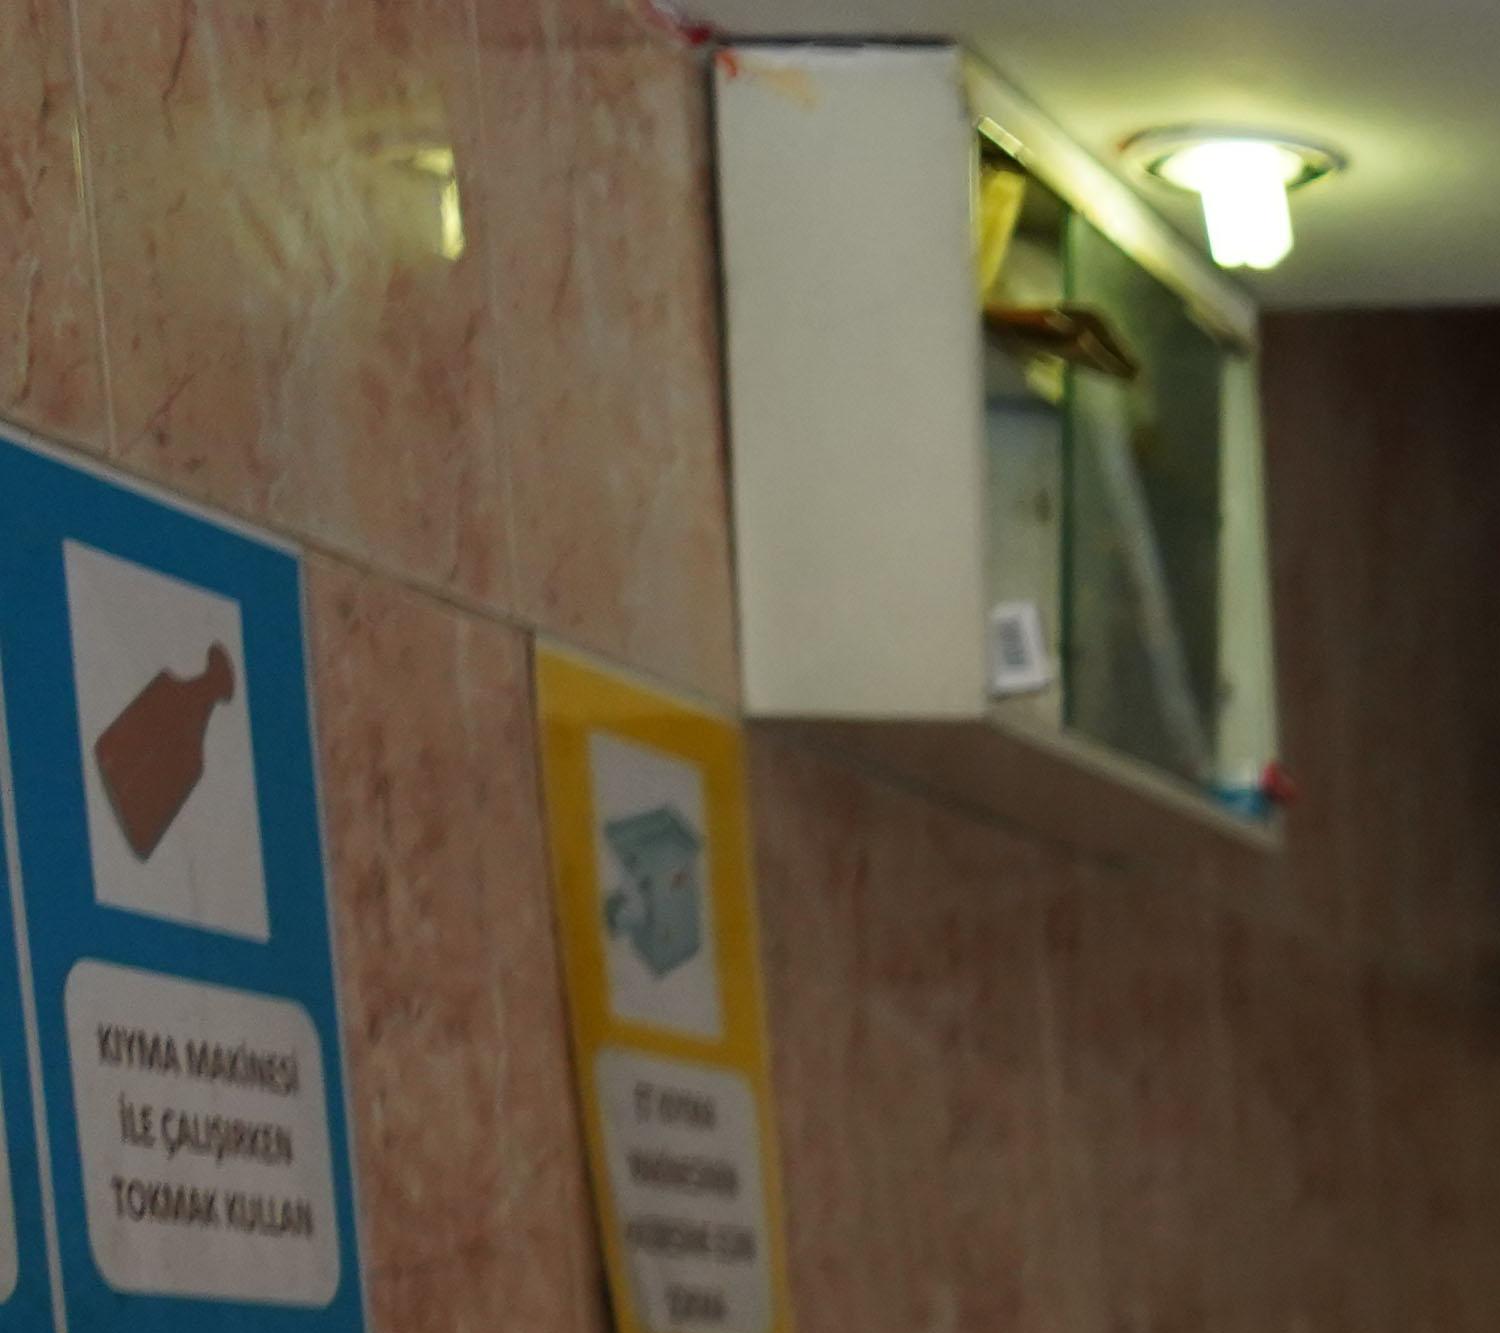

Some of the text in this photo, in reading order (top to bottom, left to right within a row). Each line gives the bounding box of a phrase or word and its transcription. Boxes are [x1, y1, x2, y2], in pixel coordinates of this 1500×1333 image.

[98, 1023, 183, 1076] KIYMA
[118, 1091, 155, 1148] İLE
[111, 1174, 314, 1240] TOKMAK KULLAN
